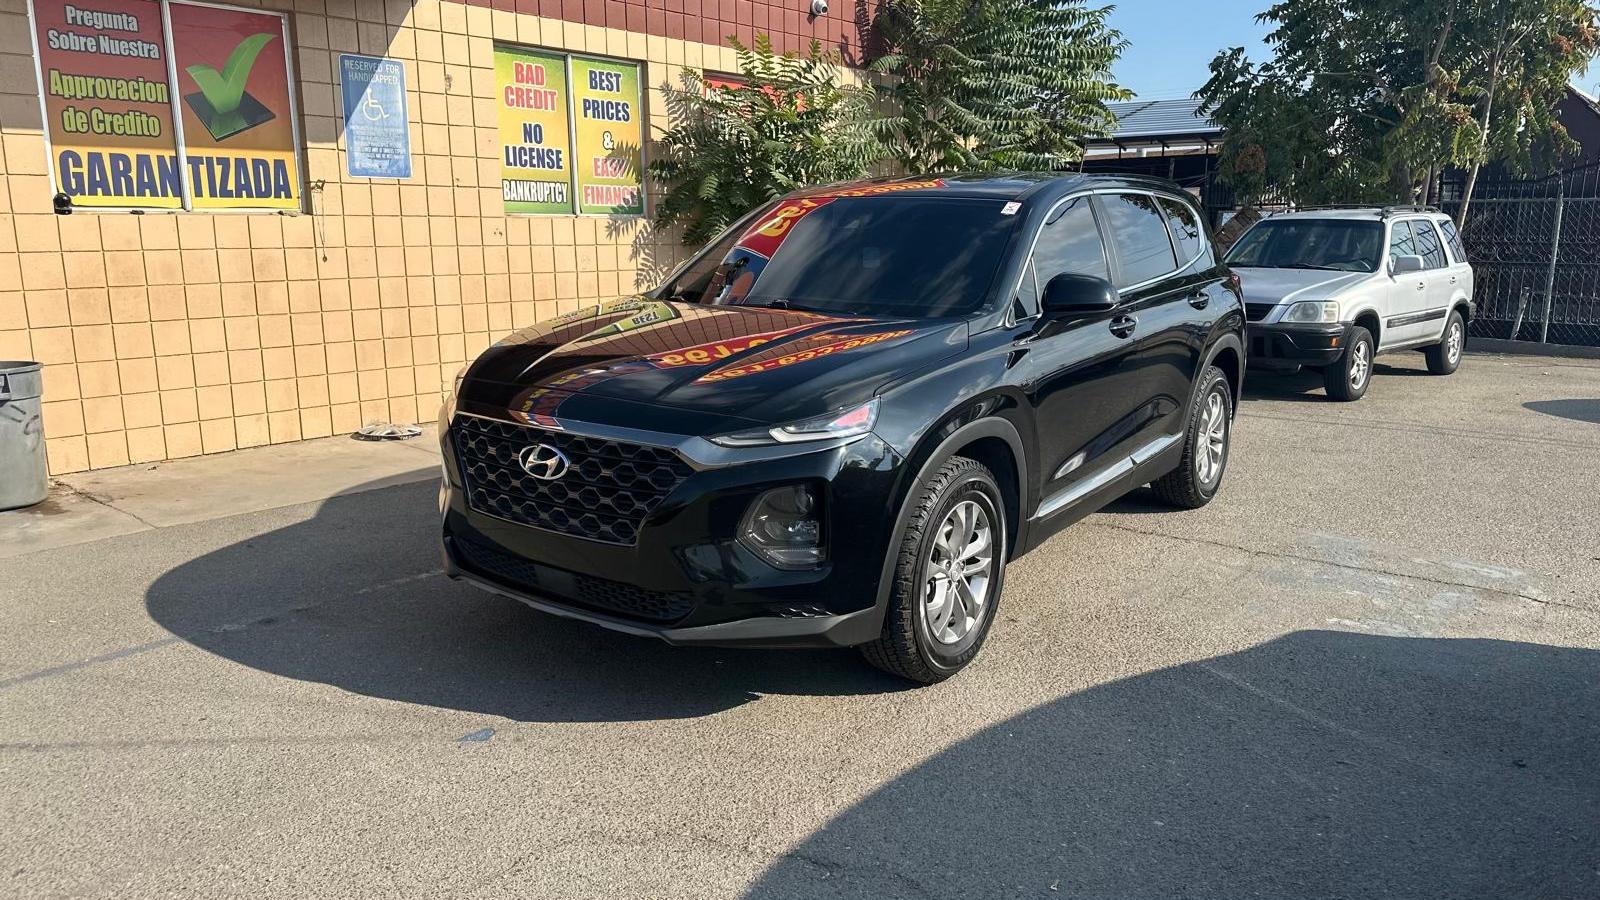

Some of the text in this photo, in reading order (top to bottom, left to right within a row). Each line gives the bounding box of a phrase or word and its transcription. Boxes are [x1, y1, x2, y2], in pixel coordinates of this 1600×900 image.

[65, 5, 139, 32] Pregunta
[47, 29, 160, 59] Sobre Nuestra
[344, 60, 400, 74] RESERVED FOR
[348, 71, 399, 84] HANDICAPPED
[514, 62, 545, 86] BAD
[49, 69, 169, 104] Approvacion
[588, 70, 621, 93] BEST
[504, 86, 557, 111] CREDIT
[582, 98, 630, 122] PRICES
[62, 107, 161, 138] de Credito
[522, 122, 543, 144] NO
[602, 131, 615, 151] &
[504, 146, 563, 170] LICENSE
[59, 150, 293, 200] GARANTIZADA
[502, 179, 568, 203] BANKRUPTCY
[583, 185, 639, 206] FINANCE
